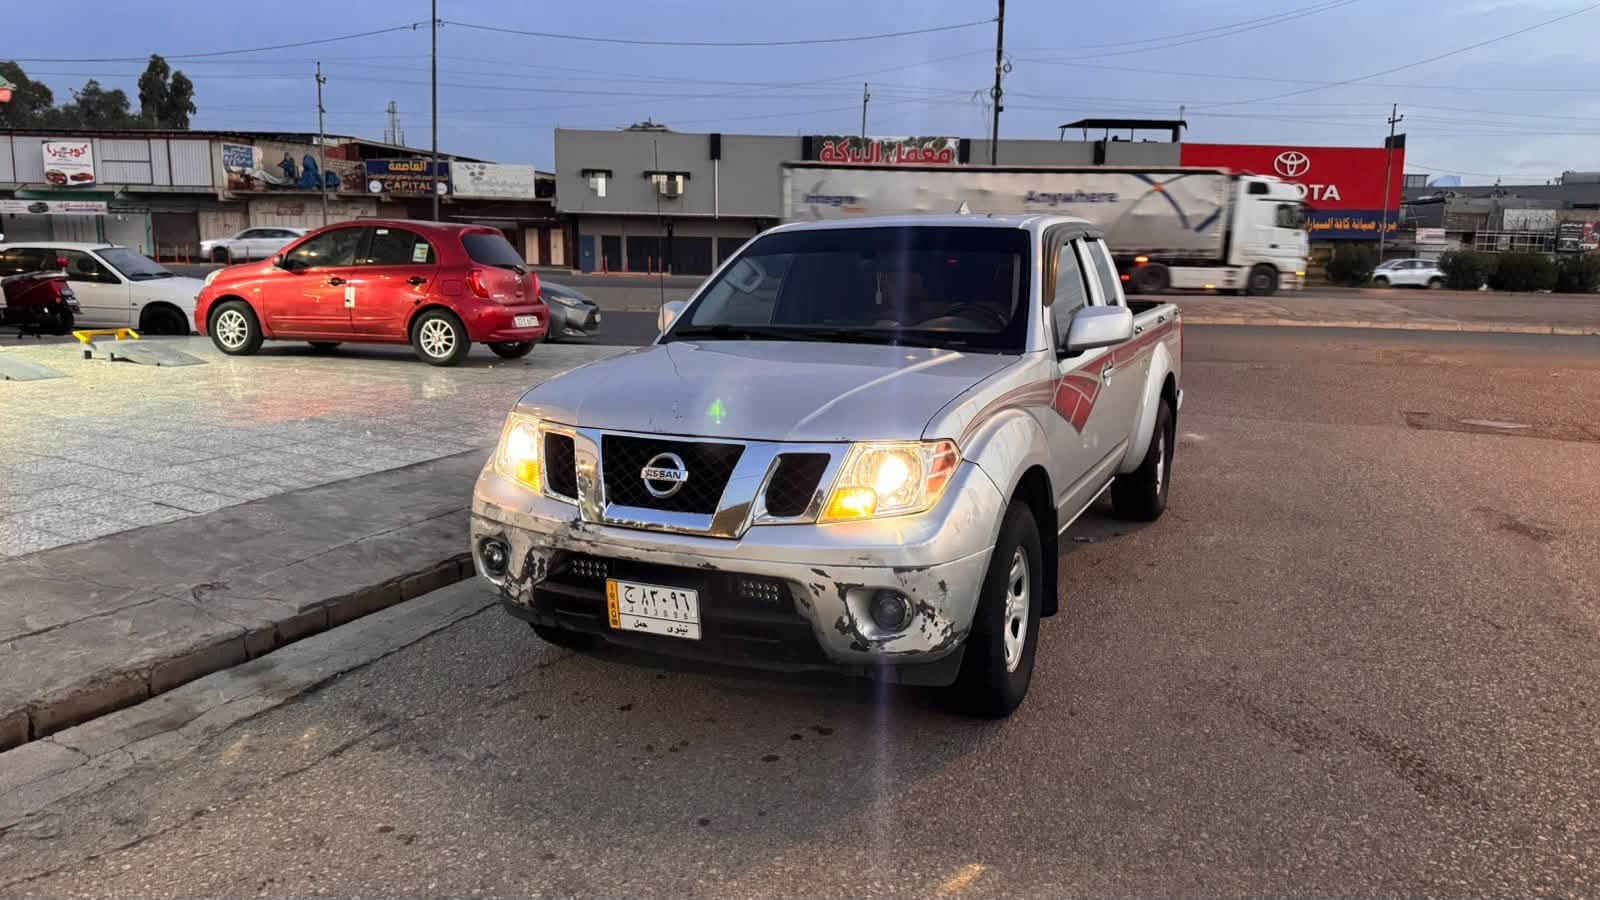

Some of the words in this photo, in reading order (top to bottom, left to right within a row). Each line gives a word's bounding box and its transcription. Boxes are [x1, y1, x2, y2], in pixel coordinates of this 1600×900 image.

[384, 181, 432, 193] CAPITAL
[1023, 189, 1120, 207] Anywhere
[645, 469, 682, 480] NISSAN
